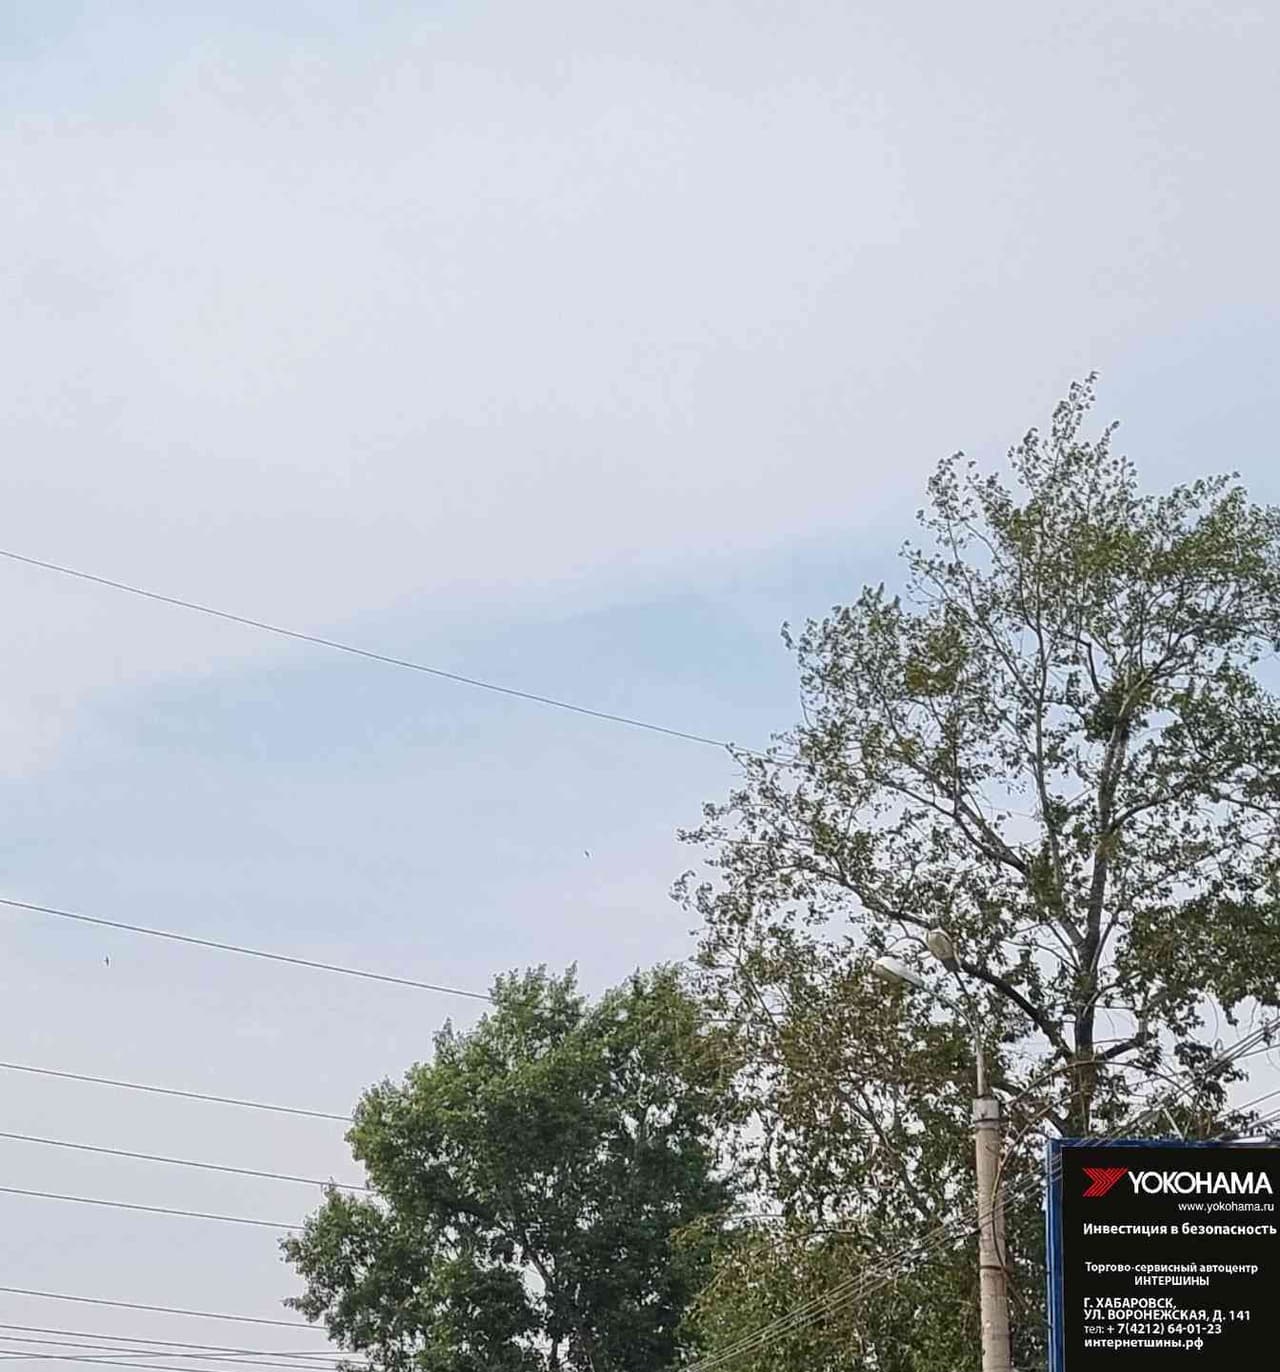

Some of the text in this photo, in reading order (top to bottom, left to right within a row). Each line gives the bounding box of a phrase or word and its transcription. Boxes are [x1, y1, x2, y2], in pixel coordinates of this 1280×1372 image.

[1128, 1171, 1273, 1194] YOKOHAMA
[1178, 1201, 1275, 1214] www.yokohama.ru
[1083, 1222, 1277, 1237] Инвестиция в безопасность
[1084, 1261, 1259, 1274] Торгово-сервисный автоцентр
[1134, 1275, 1210, 1286] ИНТЕРШИНЫ
[1083, 1297, 1177, 1310] Г. ХАБАРОВСК,
[1083, 1309, 1250, 1322] УЛ. ВОРОНЕЖСКАЯ, Д. 141
[1083, 1325, 1105, 1334] тел:
[1167, 1323, 1222, 1334] 64-01-23
[1084, 1337, 1204, 1350] интернетшины.рф
